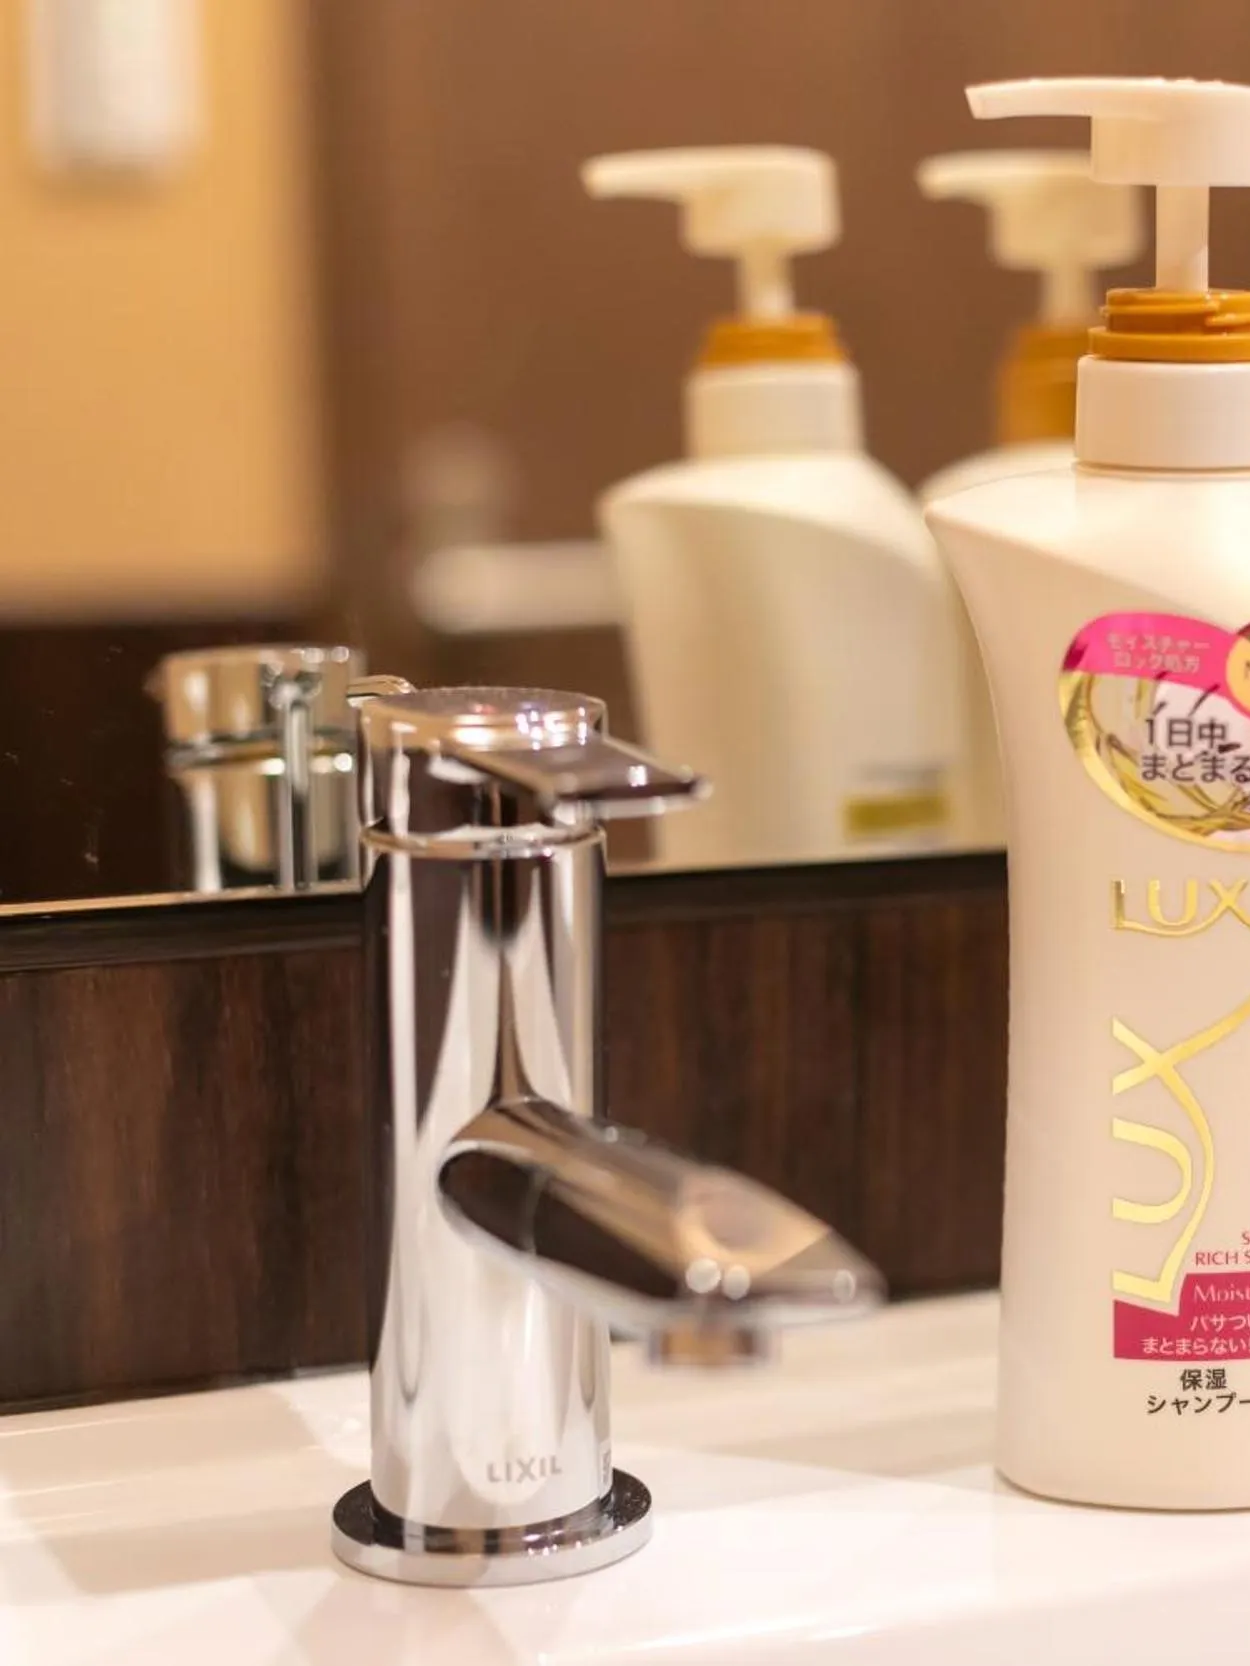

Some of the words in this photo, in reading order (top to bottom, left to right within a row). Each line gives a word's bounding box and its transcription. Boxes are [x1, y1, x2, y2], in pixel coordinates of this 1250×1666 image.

[1107, 633, 1211, 652] モイスチャー
[1114, 652, 1200, 673] ロック処方
[1144, 717, 1228, 750] 1日中
[1195, 1251, 1239, 1267] RICH
[1179, 1368, 1228, 1391] 保湿
[486, 1454, 563, 1484] LIXIL
